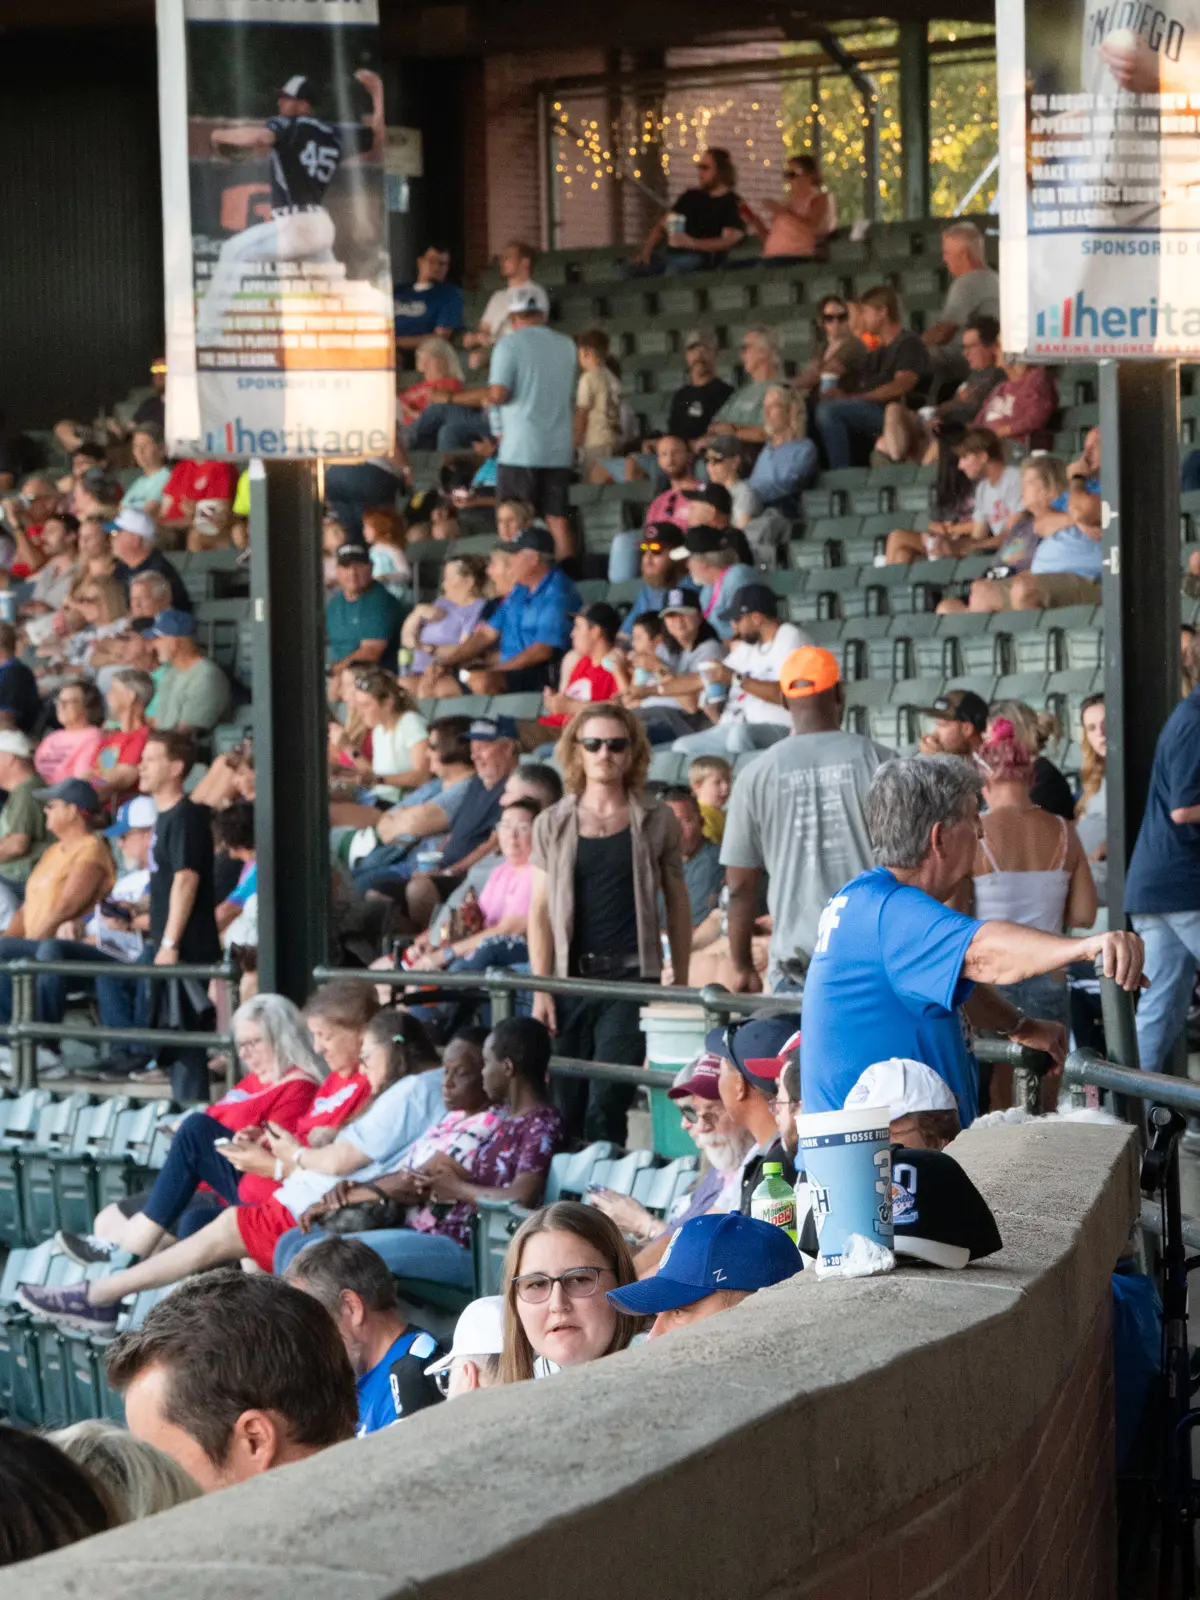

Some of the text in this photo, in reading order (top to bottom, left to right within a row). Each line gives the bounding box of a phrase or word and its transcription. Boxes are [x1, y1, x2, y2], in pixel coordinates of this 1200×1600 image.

[1138, 115, 1158, 132] SAN
[300, 140, 340, 183] 45
[1080, 240, 1189, 256] SPONSORED
[235, 416, 387, 456] heritage
[844, 1131, 874, 1143] BOSSE
[713, 1268, 728, 1284] Z
